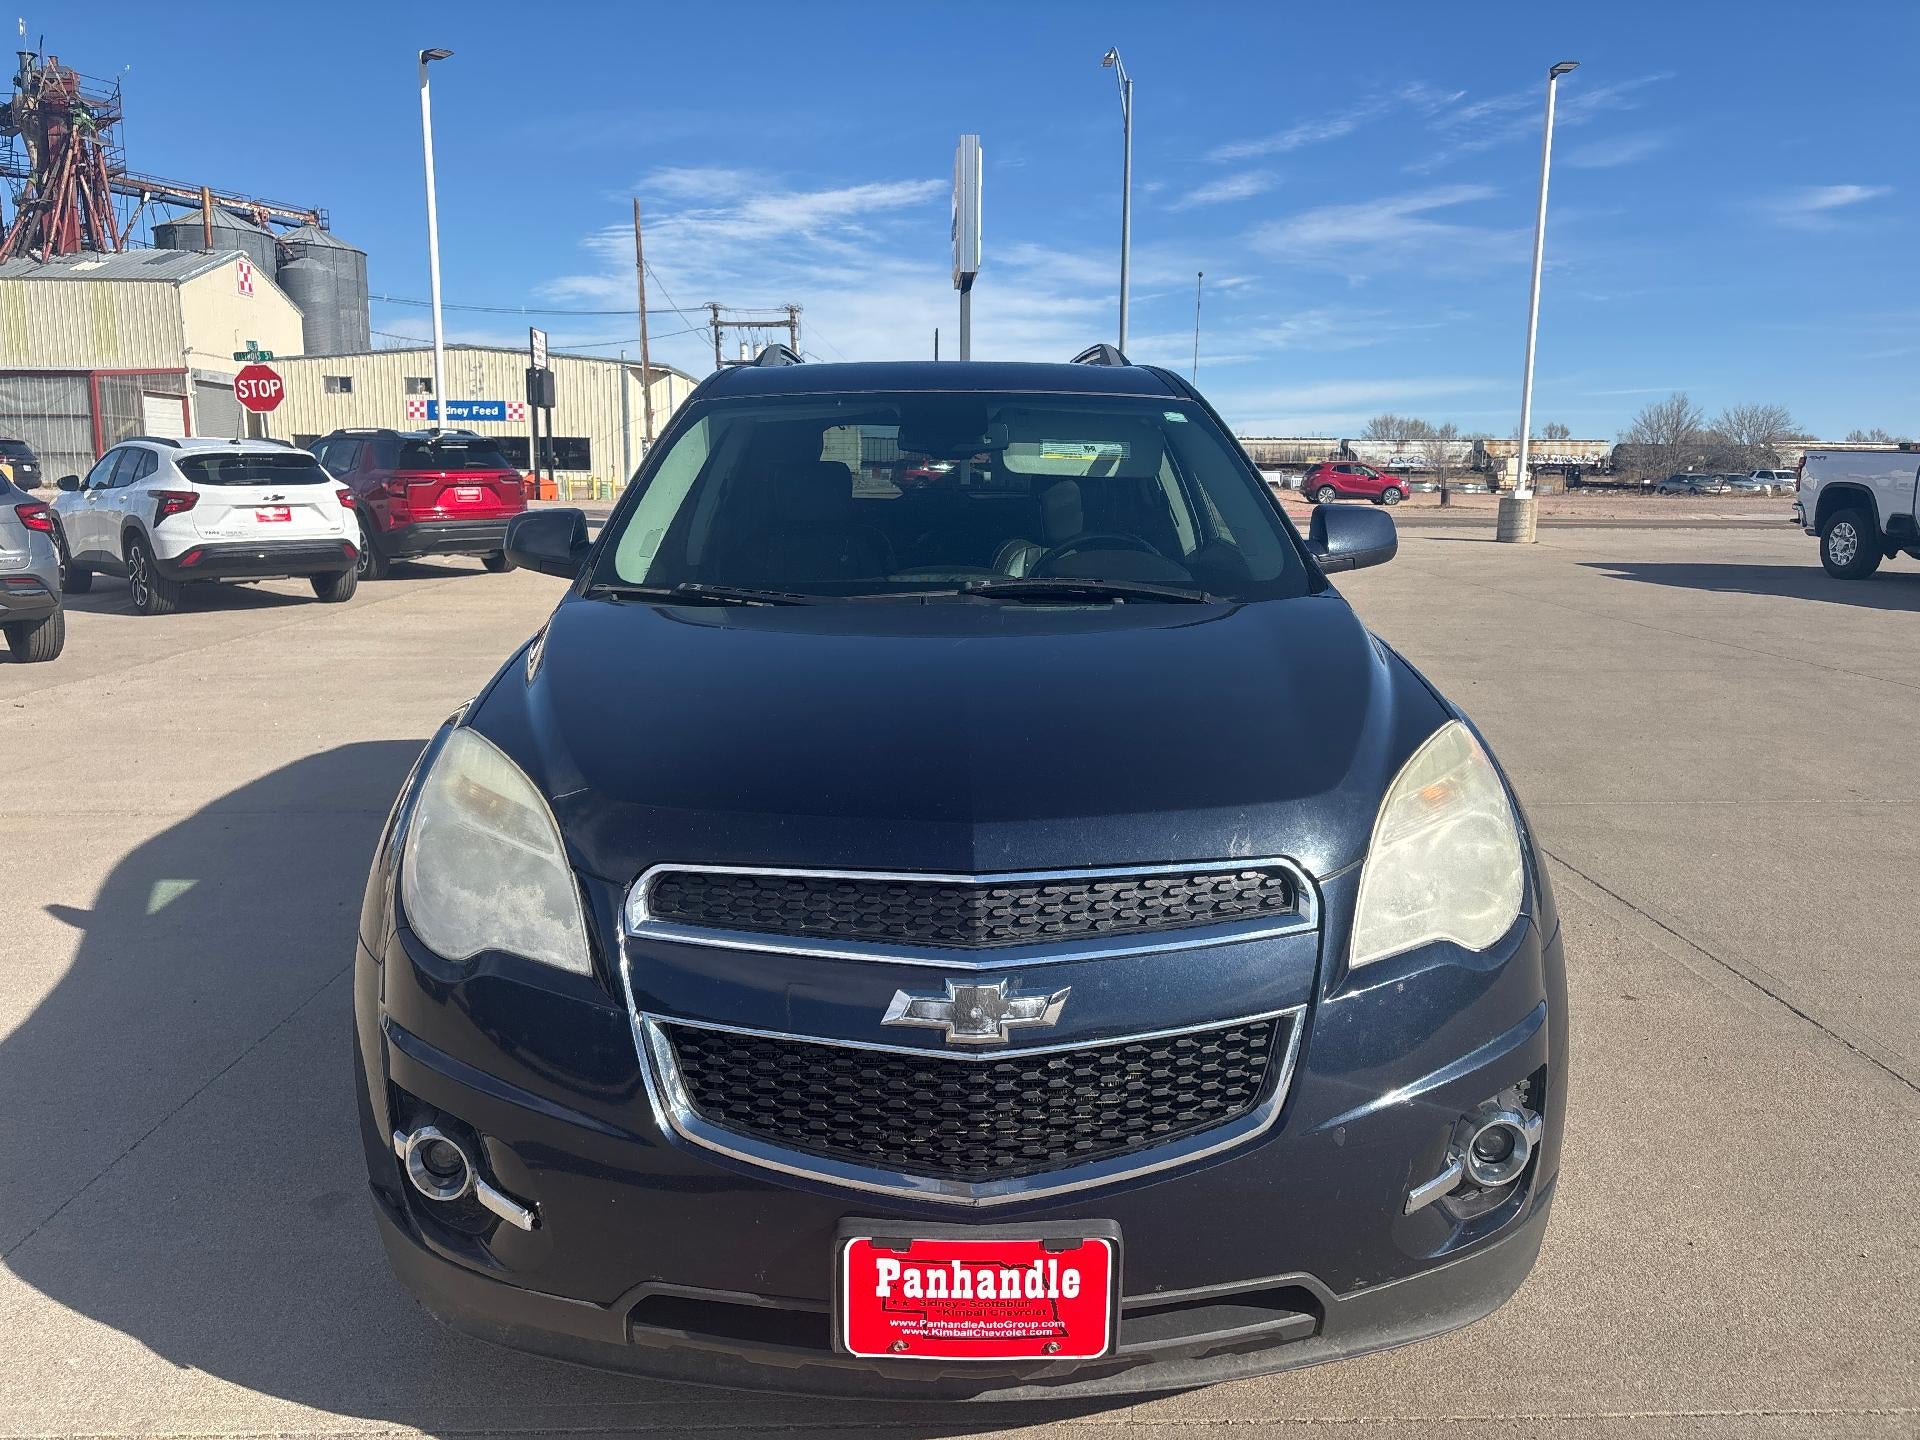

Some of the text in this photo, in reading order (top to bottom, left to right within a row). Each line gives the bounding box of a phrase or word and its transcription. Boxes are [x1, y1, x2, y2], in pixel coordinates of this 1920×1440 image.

[238, 379, 281, 399] STOP
[435, 405, 499, 417] Sdney Feed
[875, 1257, 1081, 1300] Panhandle
[919, 1299, 1032, 1309] Sidney Scottsbluff
[942, 1308, 1047, 1317] Kimball Chevrolet
[889, 1319, 1066, 1330] www.PanhandleAutoGroup.com
[901, 1328, 1053, 1338] www.KimballChevrolet.com
